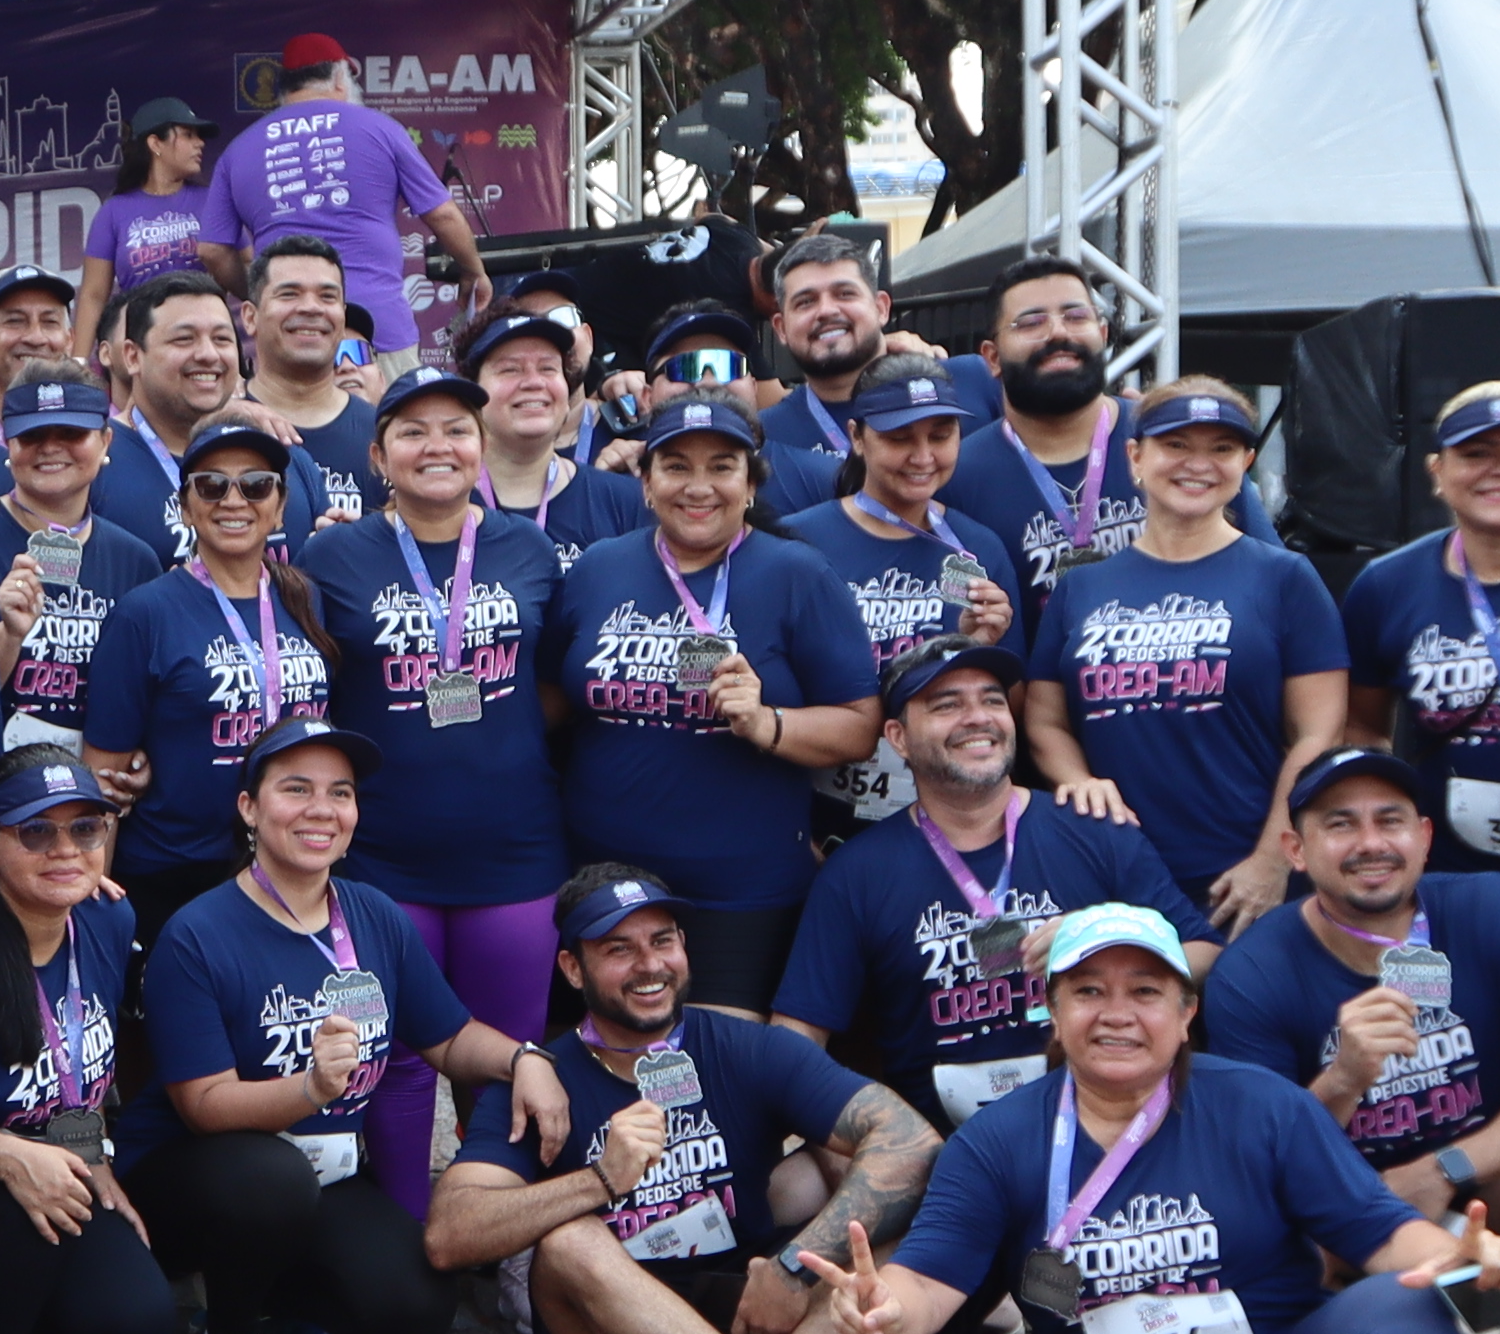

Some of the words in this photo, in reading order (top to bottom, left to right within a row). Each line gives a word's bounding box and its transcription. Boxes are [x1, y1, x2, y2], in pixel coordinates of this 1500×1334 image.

[364, 53, 537, 93] EA-AM
[266, 112, 340, 139] STAFF
[142, 220, 200, 240] CORRIDA
[857, 597, 944, 627] ORRIDA
[418, 627, 495, 654] PETRE
[868, 621, 916, 643] ESTRE
[1106, 618, 1233, 648] CORRIDA
[383, 641, 520, 692] CRE-AM
[1115, 643, 1198, 664] PEDESTRE
[13, 659, 88, 700] CREA-
[625, 664, 678, 684] PEDES
[1078, 659, 1228, 702] CREA-AM
[439, 685, 478, 701] CORRIDA
[832, 767, 892, 801] 354
[1399, 964, 1449, 977] CORRIDA
[338, 983, 380, 1000] CORRIDA
[930, 973, 1047, 1027] CREA-A
[650, 1063, 693, 1083] CORRIDA
[1370, 1067, 1451, 1105] PEDESTRE
[635, 1174, 705, 1208] PEDESRE
[1079, 1223, 1220, 1279] CORRIDA
[1093, 1265, 1190, 1296] PEDESTRE
